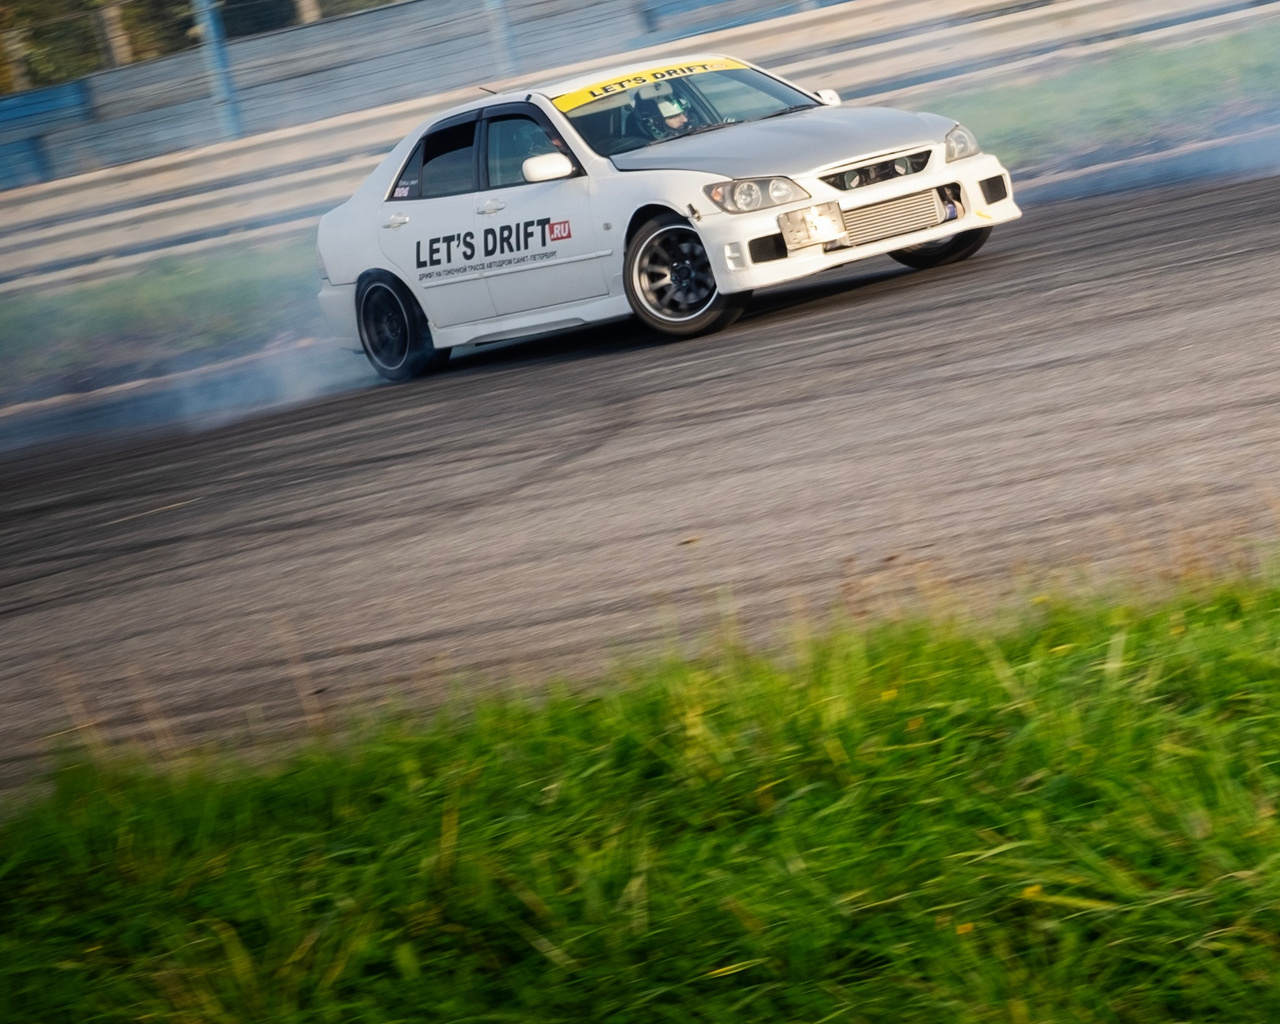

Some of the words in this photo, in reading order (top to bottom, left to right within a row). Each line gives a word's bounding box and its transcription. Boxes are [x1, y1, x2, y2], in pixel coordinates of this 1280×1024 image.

[588, 76, 647, 98] LET'S
[416, 231, 475, 269] LET'S
[467, 262, 486, 273] ТРАССЕ
[486, 259, 513, 270] АВТОДРОМ
